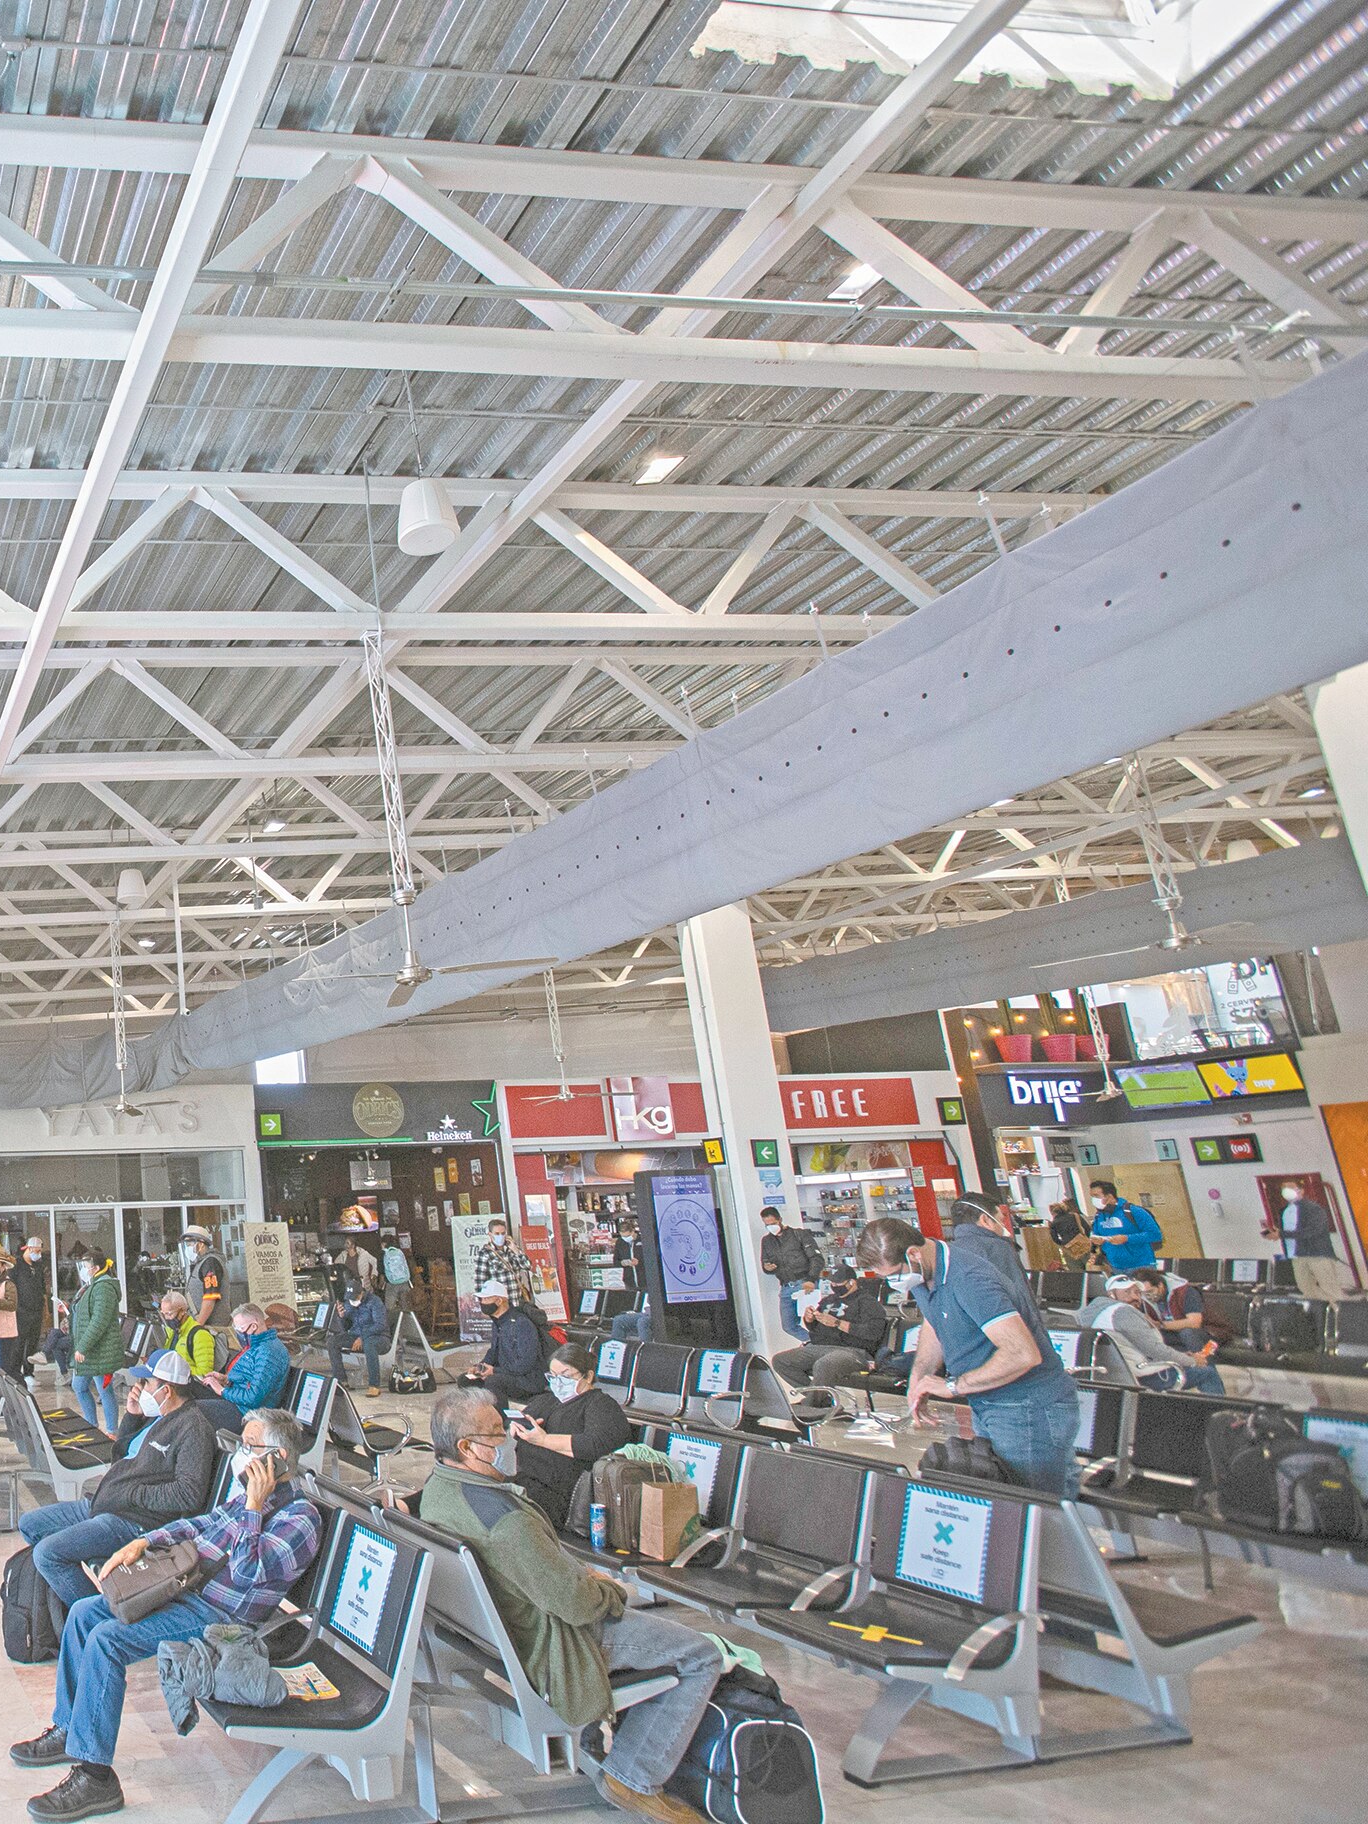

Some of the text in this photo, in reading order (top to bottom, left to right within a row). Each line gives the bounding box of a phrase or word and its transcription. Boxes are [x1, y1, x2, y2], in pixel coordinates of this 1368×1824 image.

[790, 1087, 869, 1119] FREE
[426, 1131, 473, 1141] Heineken
[924, 1507, 970, 1522] sana distancia
[933, 1547, 949, 1558] Keep
[920, 1553, 962, 1569] safe distance
